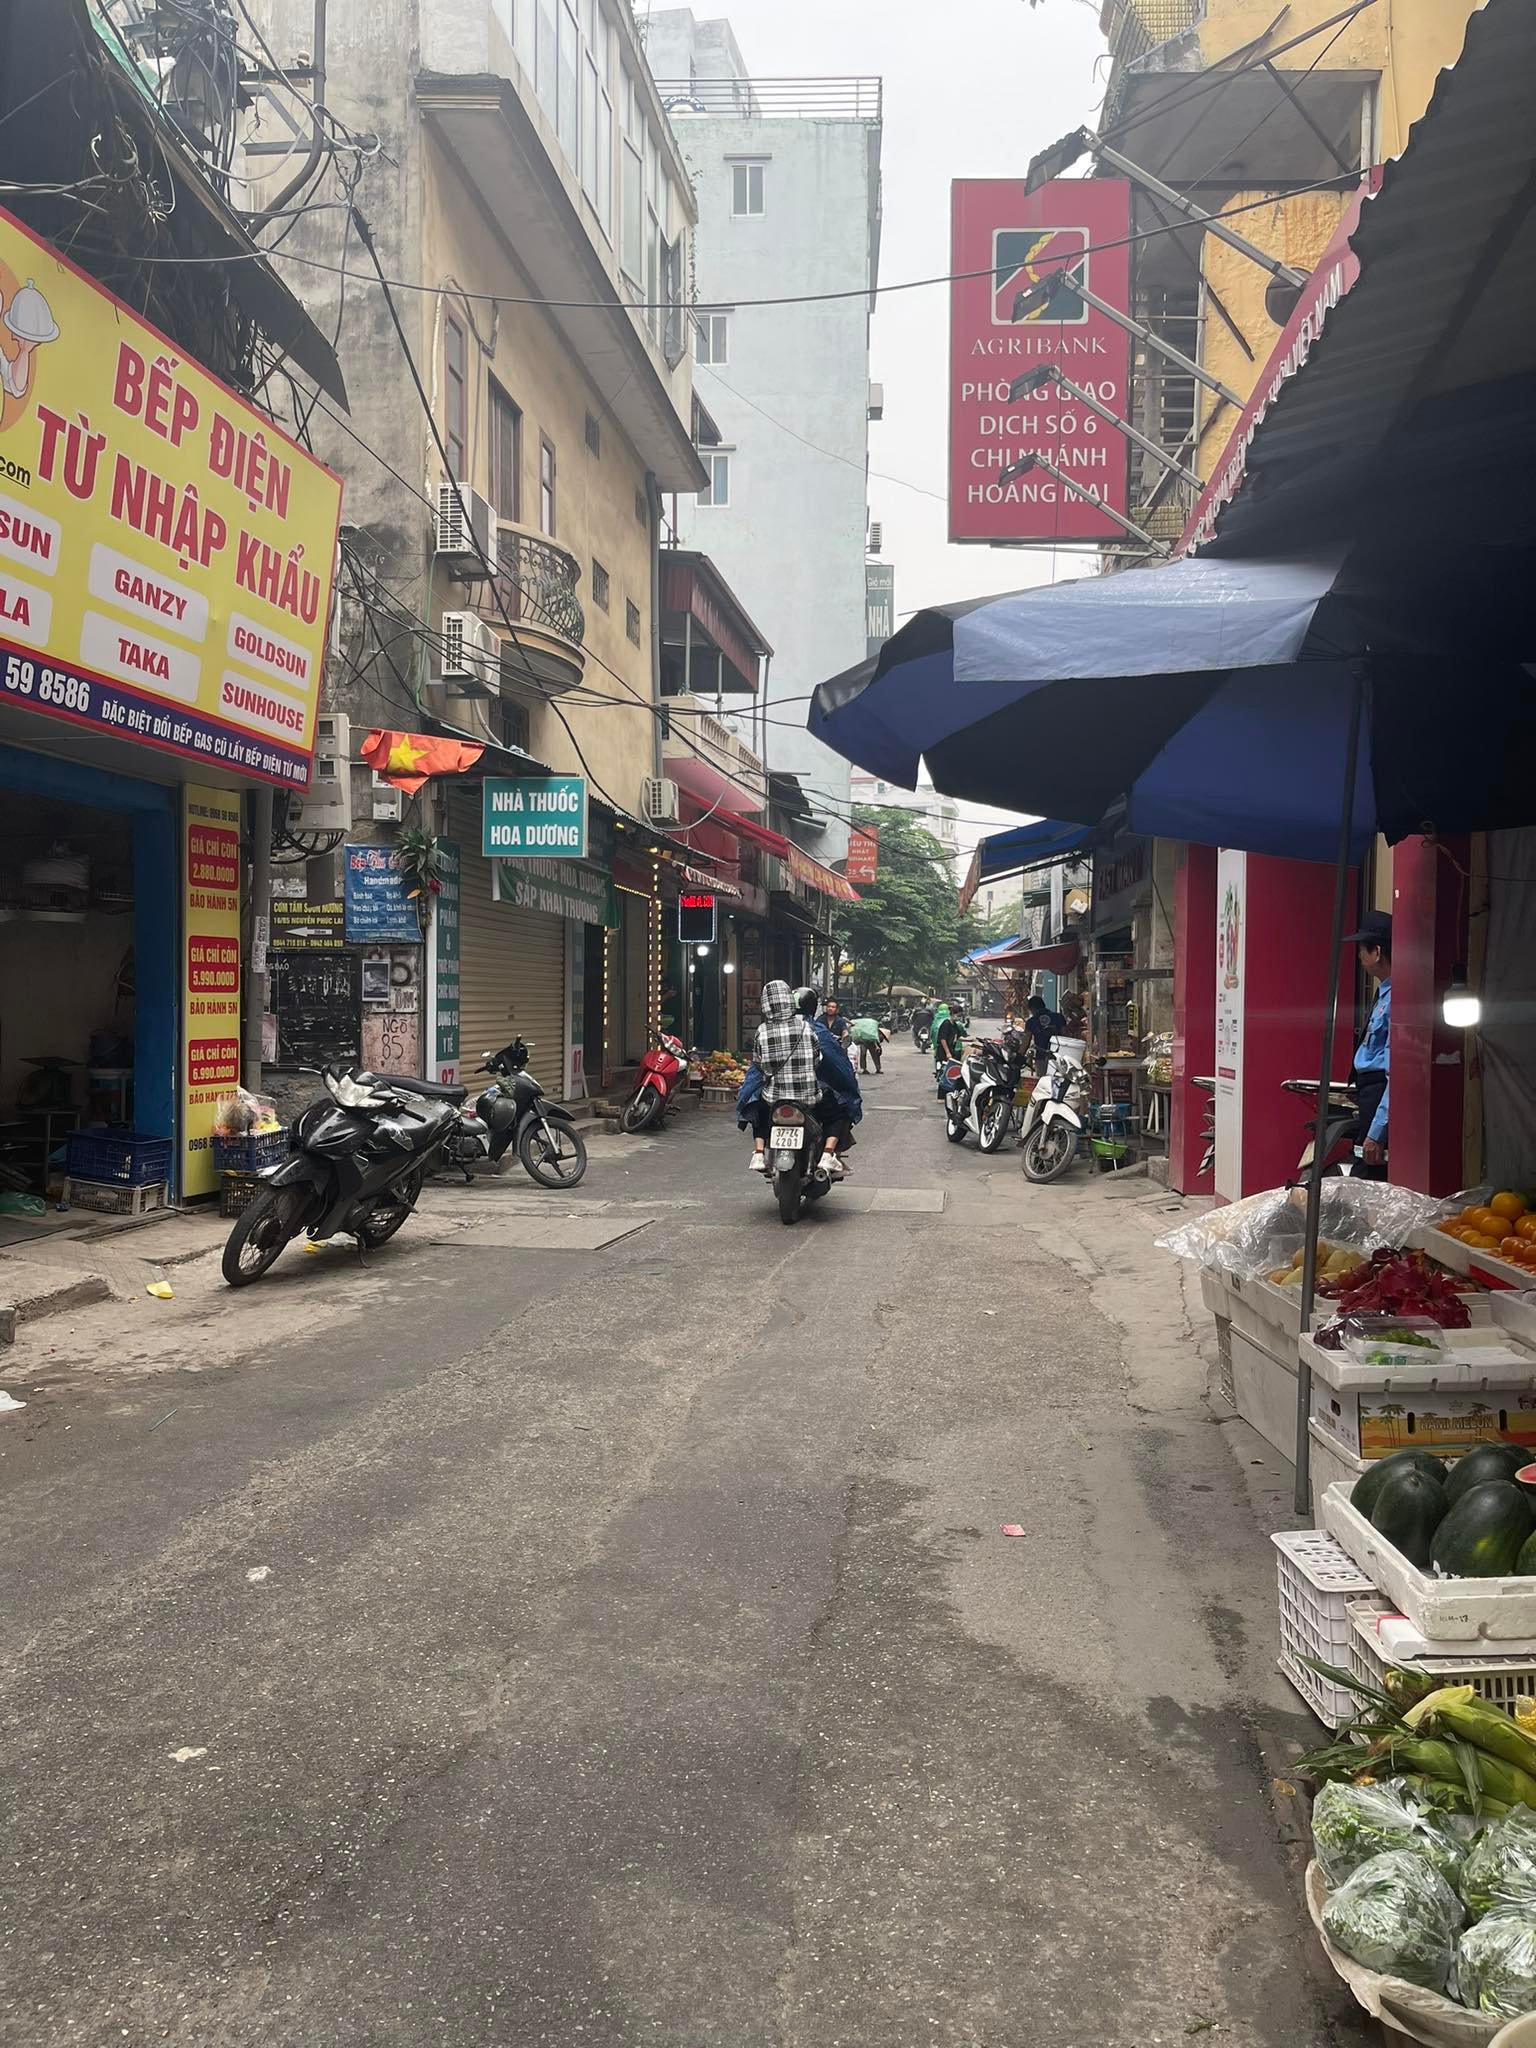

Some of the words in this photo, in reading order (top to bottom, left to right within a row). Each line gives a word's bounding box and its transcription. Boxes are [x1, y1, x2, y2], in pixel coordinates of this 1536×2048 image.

[971, 336, 1108, 355] AGRIBANK
[1056, 381, 1117, 401] GAO
[113, 341, 199, 448] BẾP
[208, 412, 291, 520] ĐIỆN
[980, 415, 1038, 440] DỊCH
[1045, 409, 1077, 434] SỐ
[1083, 415, 1097, 434] 6
[1064, 483, 1108, 503] MAI
[36, 404, 106, 500] TỪ
[110, 452, 227, 571] NHẬP
[235, 529, 320, 625] KHẨU
[115, 568, 187, 620] GANZY
[117, 637, 170, 680] TAKA
[235, 626, 306, 678] GOLDSUN
[5, 656, 34, 694] 59
[39, 668, 91, 713] 8586
[222, 682, 304, 732] SUNHOUSE
[101, 700, 125, 725] ĐẶC
[127, 709, 152, 734] BIỆT
[153, 715, 171, 738] ĐỔI
[172, 722, 192, 745] BẾP
[194, 733, 212, 752] GAS
[214, 737, 228, 756] CŨ
[228, 740, 245, 762] LẤY
[245, 747, 261, 767] BẾP
[262, 753, 282, 775] ĐIỆN
[492, 788, 524, 811] NHÀ
[529, 785, 579, 812] THUỐC
[191, 835, 205, 855] GIÁ
[206, 836, 219, 857] CHỈ
[221, 839, 237, 859] CÒN
[491, 825, 521, 845] HOA
[525, 824, 579, 846] DƯƠNG
[560, 864, 578, 888] HOA
[190, 889, 205, 908] BẢO
[207, 893, 226, 911] HÀNH
[228, 897, 238, 912] 5N
[515, 876, 537, 908] SẮP
[540, 888, 563, 916] KHAI
[191, 944, 205, 963] GIÁ
[206, 943, 220, 963] CHỈ
[221, 945, 237, 964] CÒN
[190, 997, 205, 1015] BẢO
[207, 999, 226, 1015] HÀNH
[228, 1001, 238, 1015] 5N
[191, 1046, 205, 1062] GIÁ
[206, 1044, 220, 1061] CHỈ
[221, 1044, 237, 1059] CÒN
[382, 1033, 404, 1060] 85
[189, 1090, 204, 1105] BẢO
[189, 1137, 208, 1152] 0968
[776, 1129, 799, 1138] 37-Z4
[776, 1138, 798, 1147] 4201
[1452, 1414, 1493, 1430] MELON
